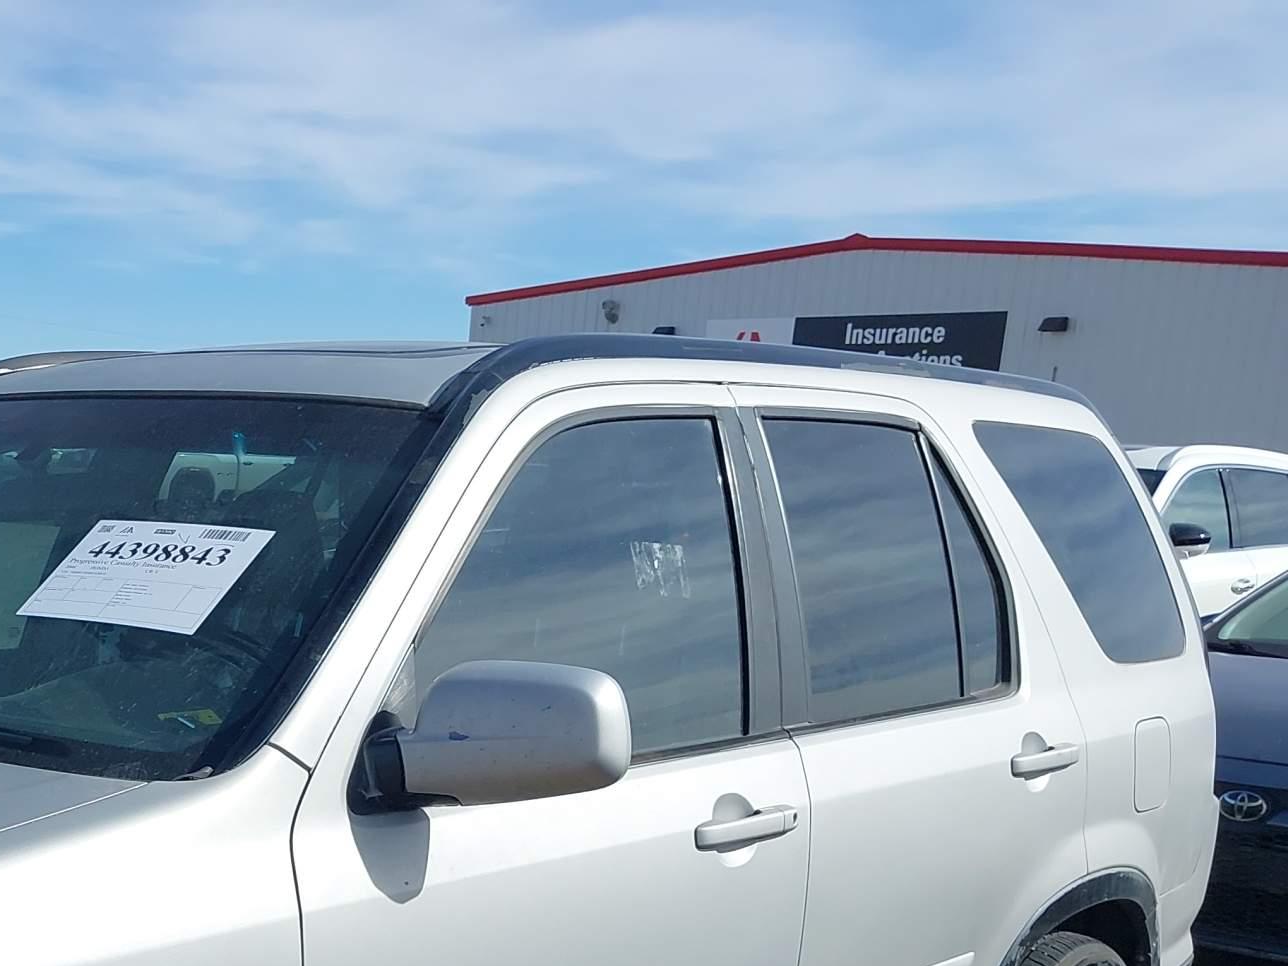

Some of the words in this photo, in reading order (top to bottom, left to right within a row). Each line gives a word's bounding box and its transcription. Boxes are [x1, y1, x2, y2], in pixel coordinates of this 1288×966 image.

[844, 322, 945, 345] Insurance
[88, 540, 233, 567] 44398843
[142, 561, 177, 570] Insurance
